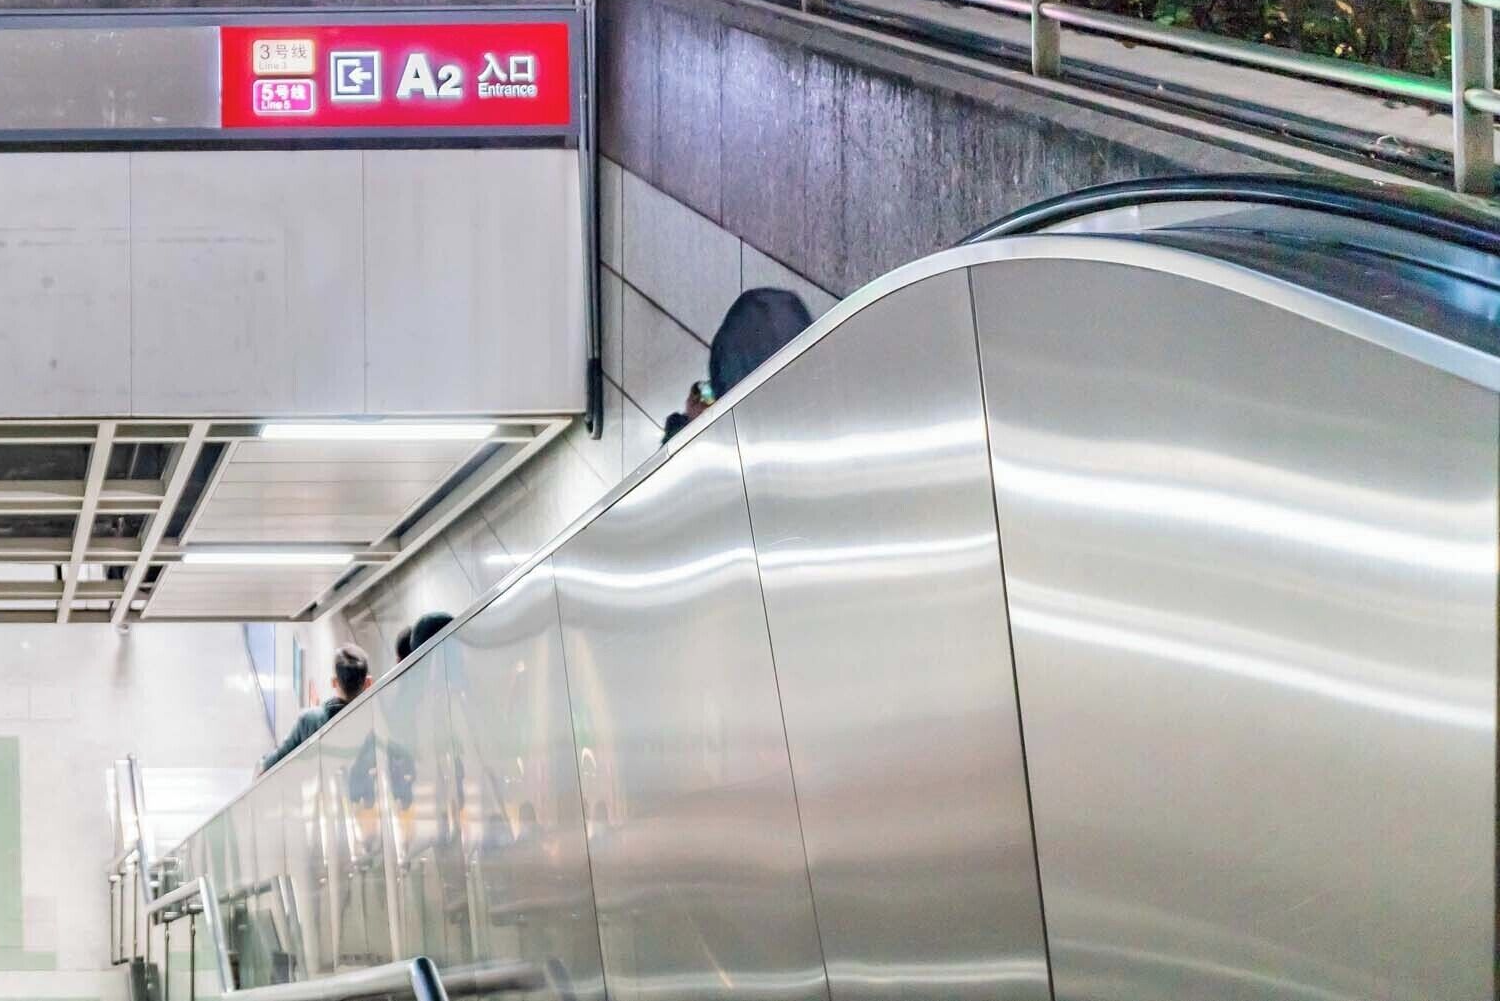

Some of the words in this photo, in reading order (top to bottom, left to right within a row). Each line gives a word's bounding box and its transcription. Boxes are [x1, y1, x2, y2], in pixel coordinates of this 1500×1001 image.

[259, 43, 308, 60] 3号线
[396, 53, 463, 99] A2
[478, 52, 535, 83] 入口
[478, 82, 537, 99] Entrance
[261, 100, 283, 111] Line
